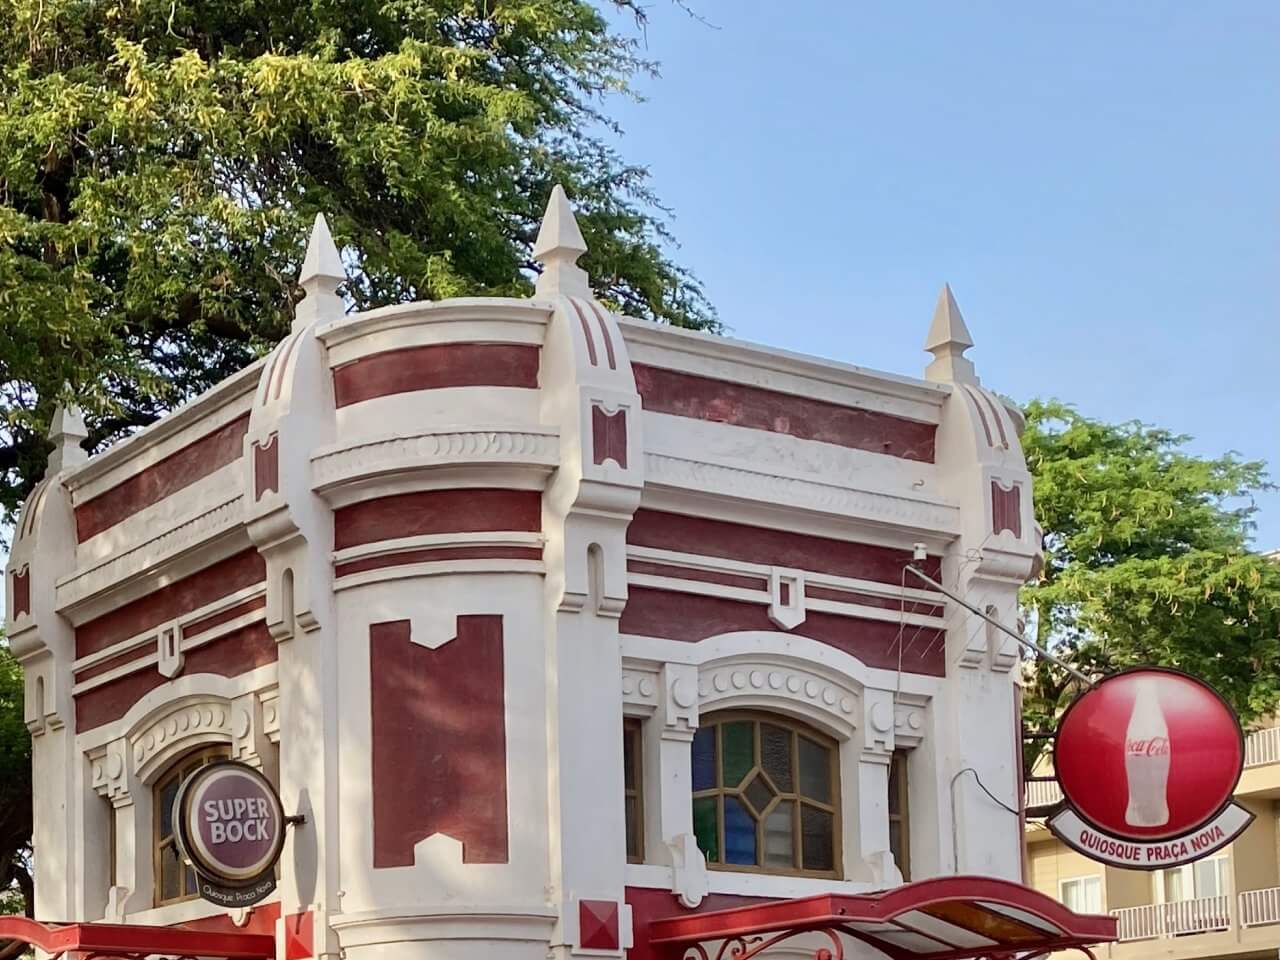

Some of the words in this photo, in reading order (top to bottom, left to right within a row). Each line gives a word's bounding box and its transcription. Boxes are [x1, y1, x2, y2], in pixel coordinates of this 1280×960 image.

[204, 798, 270, 822] SUPER
[211, 819, 270, 844] BOCK
[1080, 830, 1141, 861] QUIOSQUE
[1146, 842, 1189, 861] PRAÇA
[1191, 825, 1225, 853] NOVA
